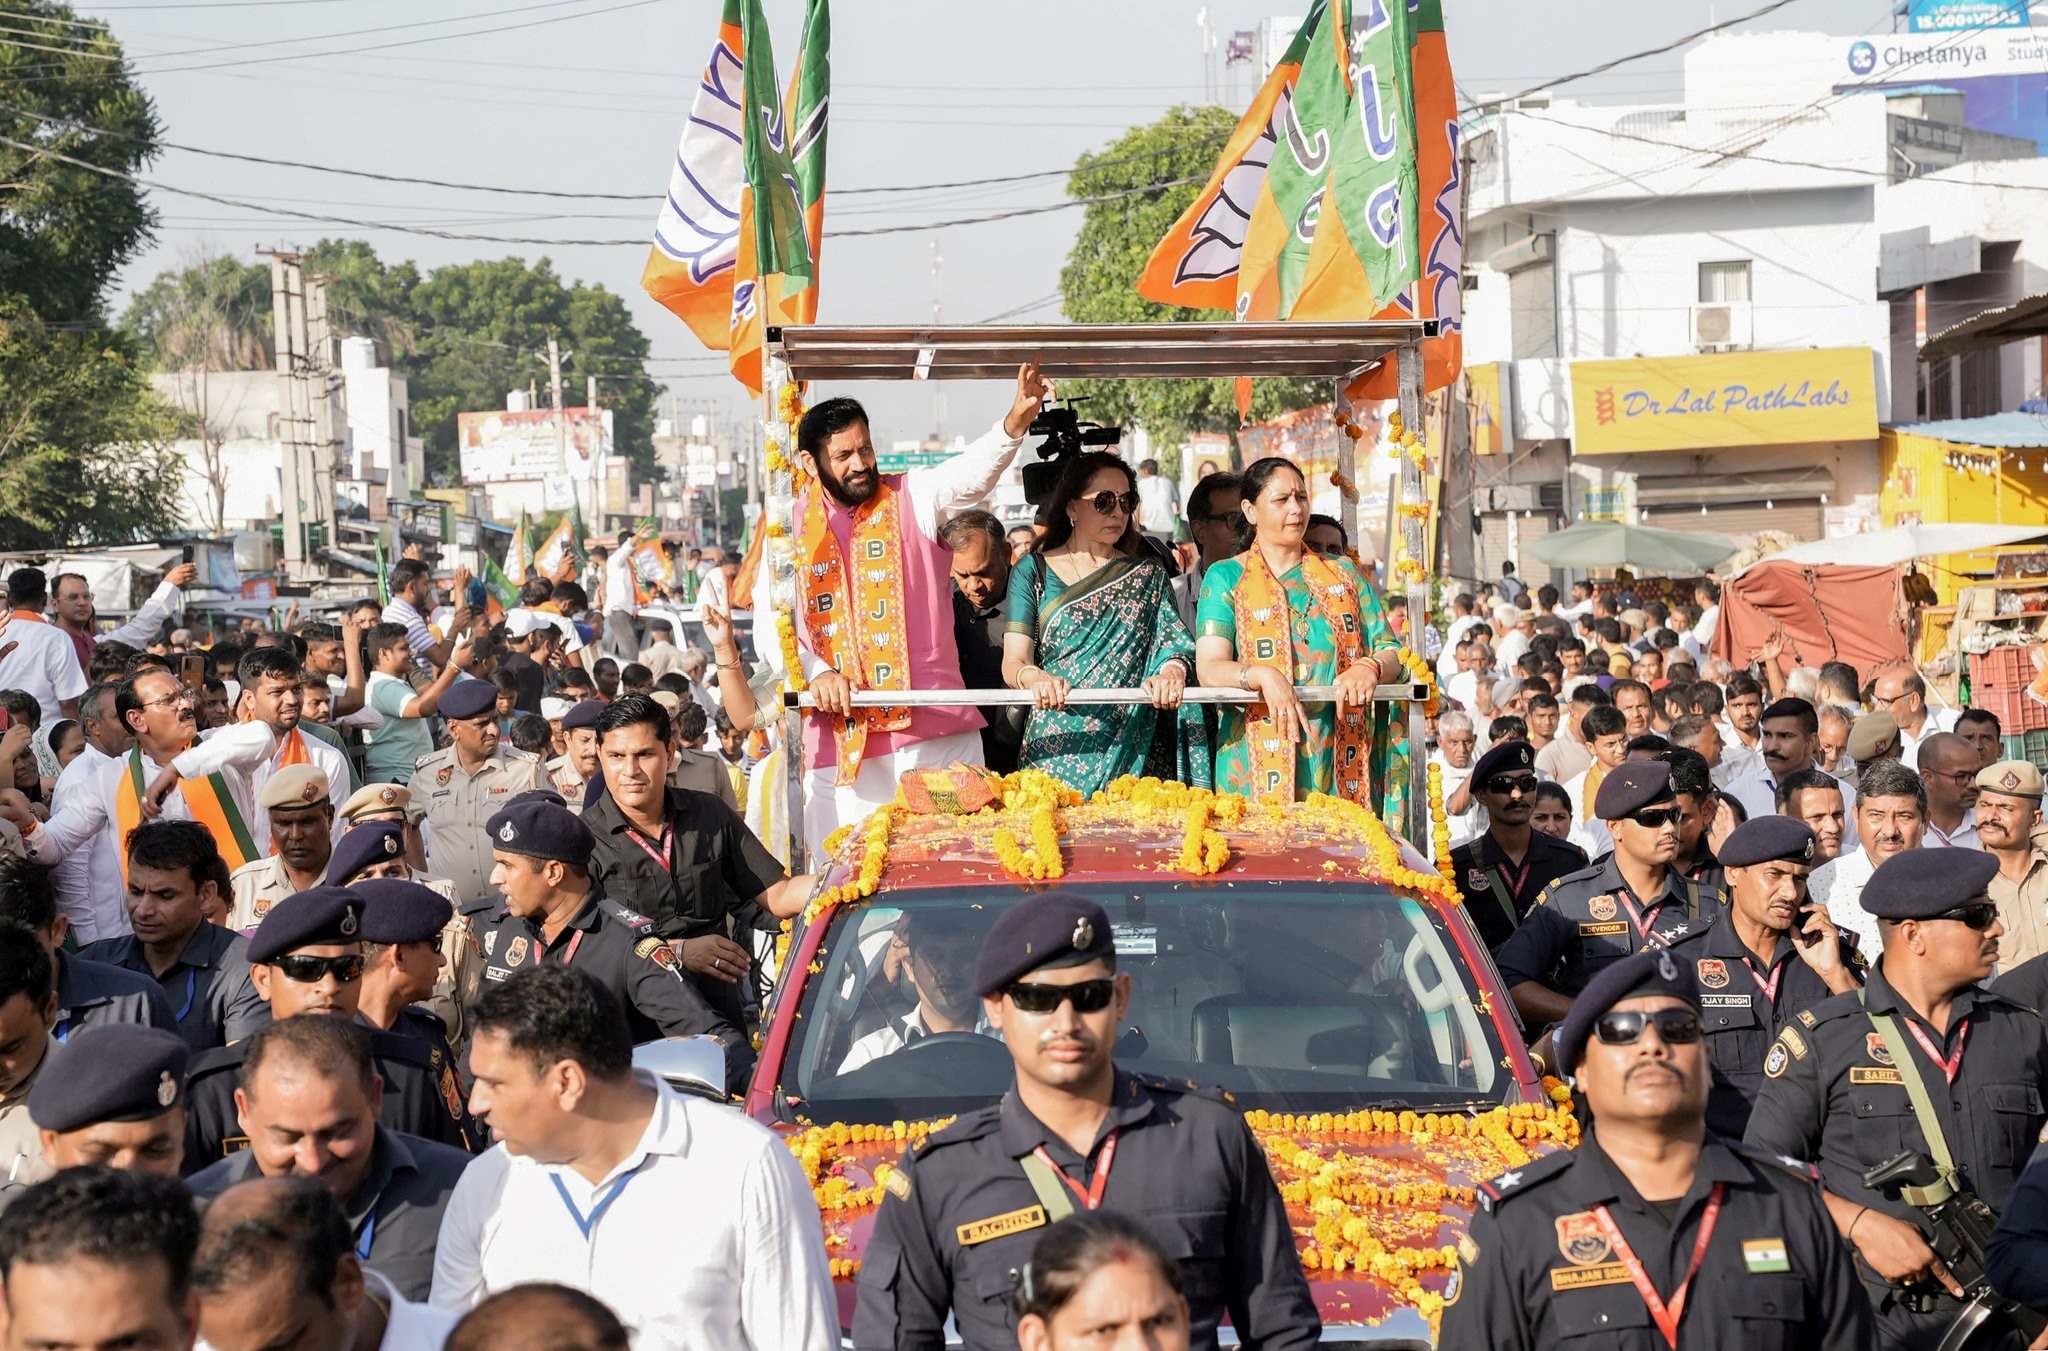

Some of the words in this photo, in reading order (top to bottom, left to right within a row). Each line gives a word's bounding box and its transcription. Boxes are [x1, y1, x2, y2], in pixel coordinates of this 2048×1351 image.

[1883, 45, 1987, 67] Chetanya
[1622, 390, 1660, 417] Dr
[1665, 388, 1716, 414] Lal
[1722, 379, 1849, 414] PathLabs
[1864, 1071, 1897, 1080] SAHIL
[970, 1212, 1031, 1238] SACHIN
